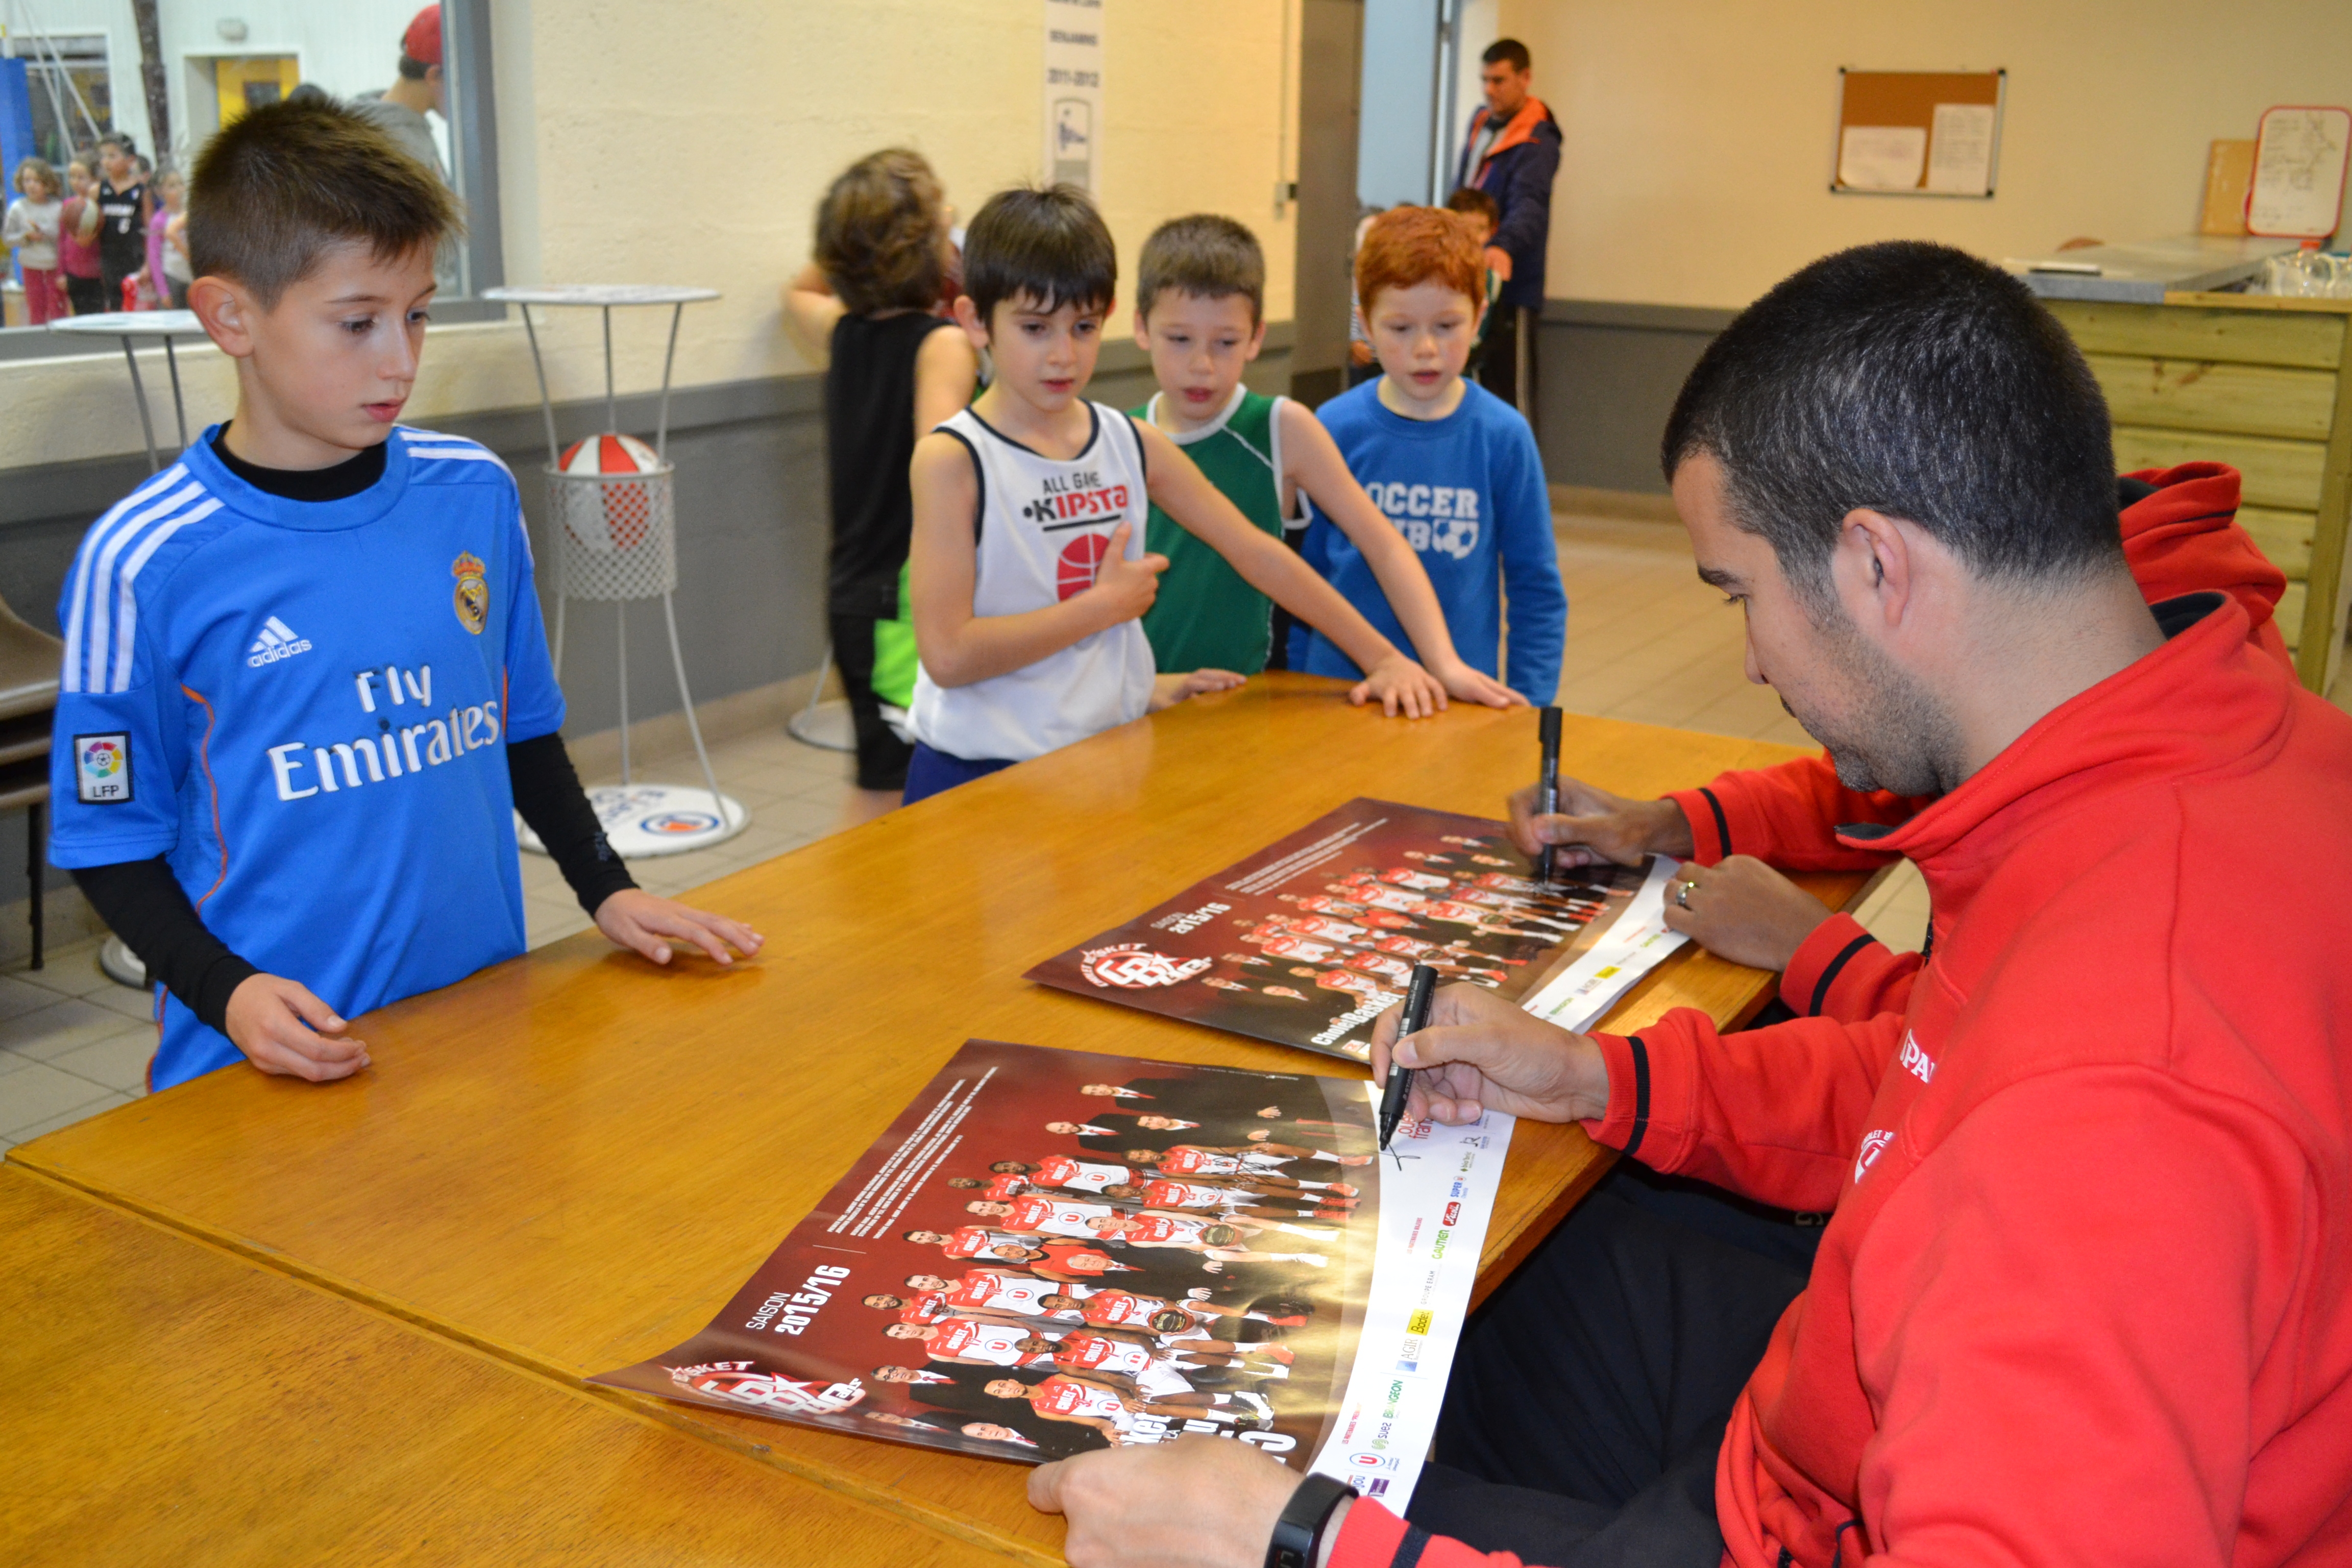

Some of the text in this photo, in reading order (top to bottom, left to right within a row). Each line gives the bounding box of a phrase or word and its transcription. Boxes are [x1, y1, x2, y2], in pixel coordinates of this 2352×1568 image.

[1043, 476, 1069, 494] ALL
[1365, 482, 1479, 518] OCCER
[248, 639, 312, 668] adidas
[353, 664, 432, 713] Fly
[266, 700, 500, 801] Emirates
[92, 785, 119, 797] LFP
[1450, 1182, 1462, 1197] SUPER
[1431, 1230, 1450, 1259] GAUTIER
[774, 1265, 851, 1335] 2015/16
[1013, 1291, 1028, 1299] U
[745, 1292, 791, 1330] SAISON
[946, 1328, 969, 1350] CHOLET
[991, 1341, 1008, 1351] U
[1401, 1338, 1418, 1360] AGIR
